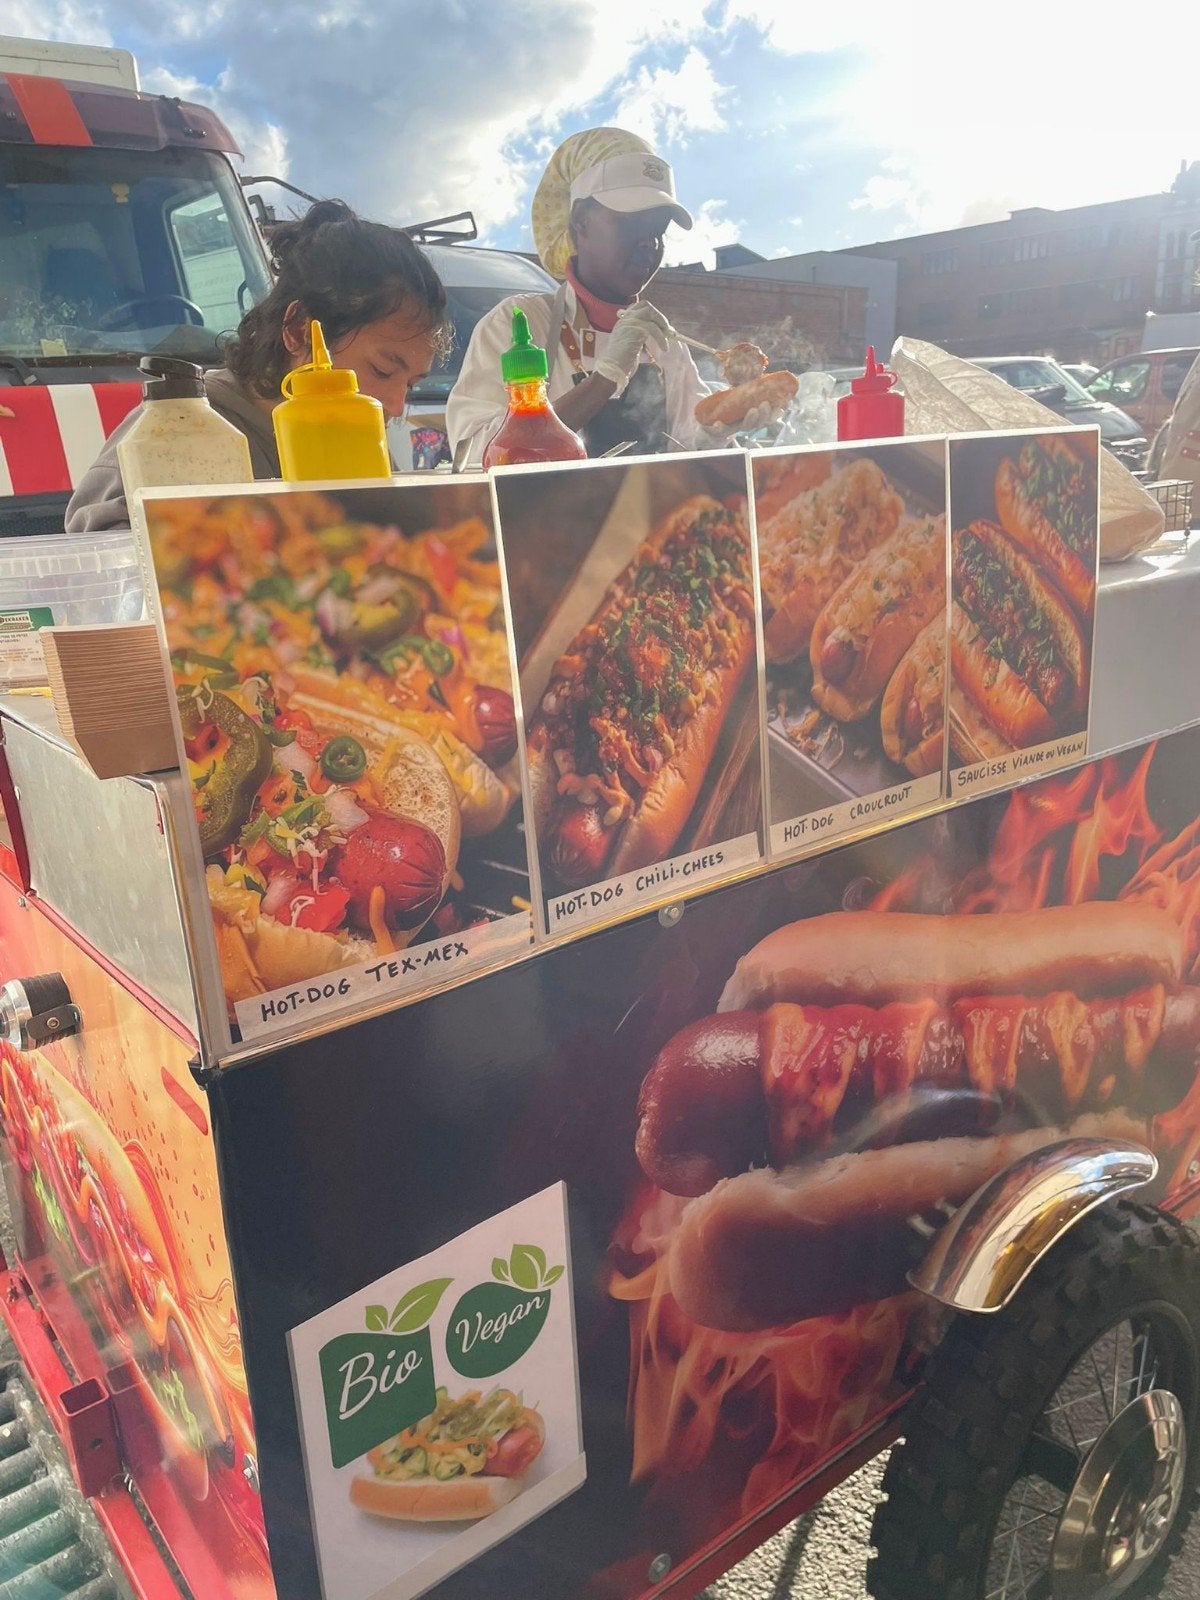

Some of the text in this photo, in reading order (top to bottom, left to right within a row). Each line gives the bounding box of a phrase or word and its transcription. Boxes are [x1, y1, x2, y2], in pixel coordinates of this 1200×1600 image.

[1056, 741, 1083, 757] VEGAN
[850, 786, 912, 819] CROUCROUT
[261, 941, 469, 1022] HOT-DOG TEX-MEX
[455, 1294, 545, 1353] Vegan
[338, 1348, 423, 1420] Bio
